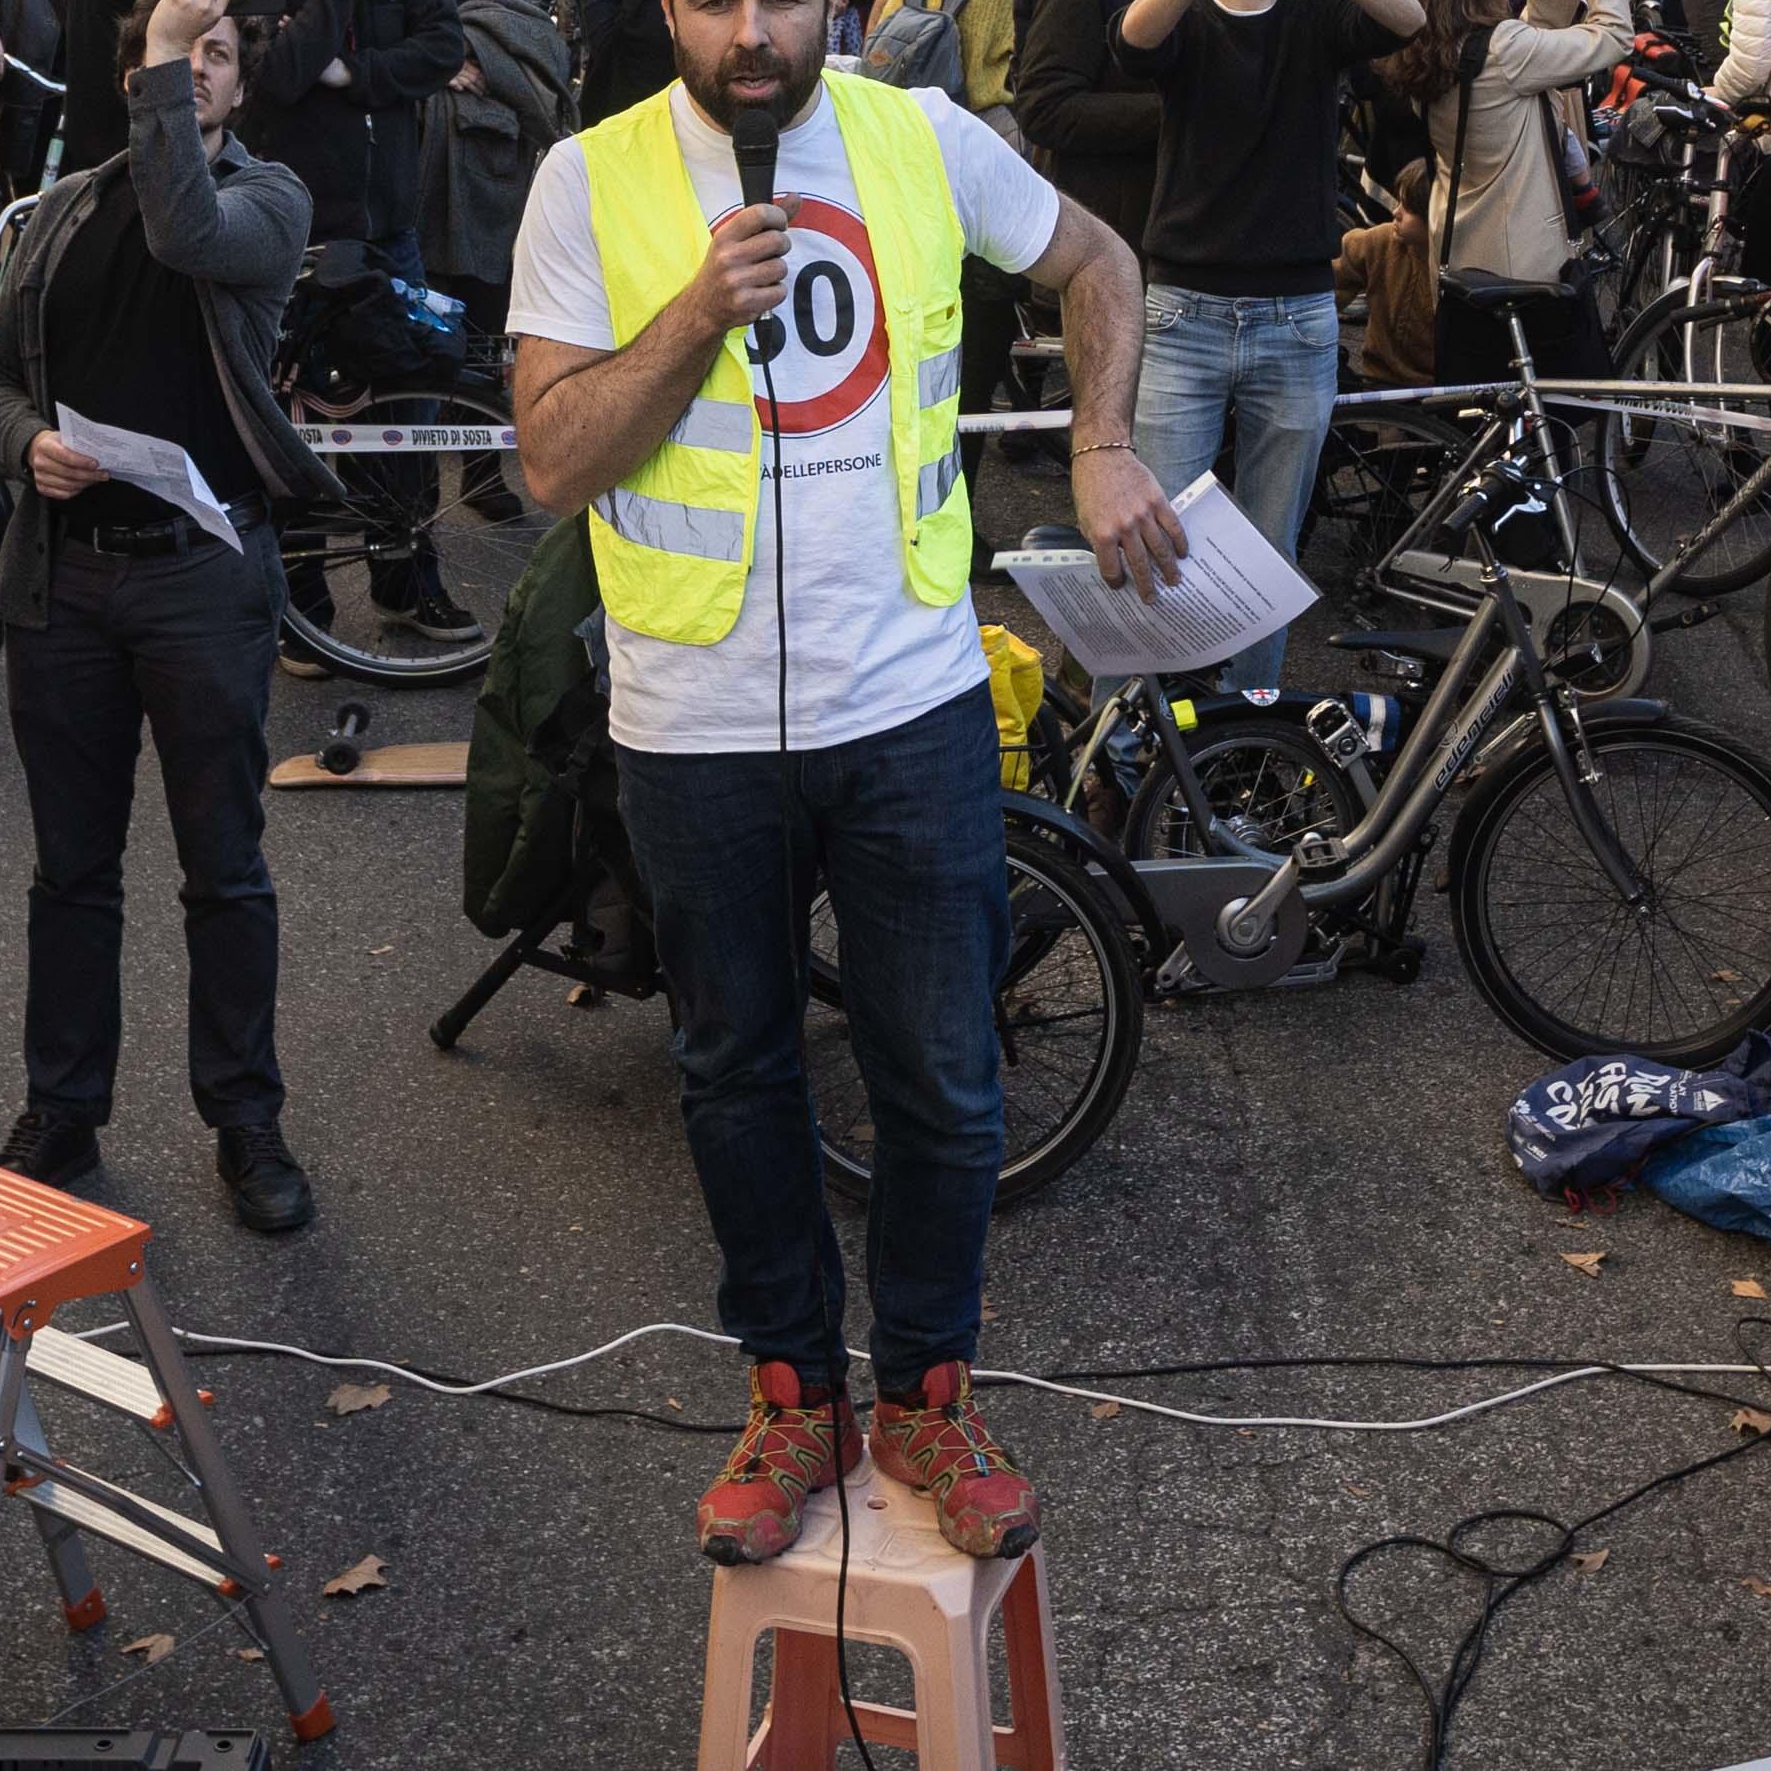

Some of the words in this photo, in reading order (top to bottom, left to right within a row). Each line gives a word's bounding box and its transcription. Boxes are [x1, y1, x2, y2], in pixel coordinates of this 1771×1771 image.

[411, 429, 449, 446] DIVIETO
[451, 429, 460, 446] DI
[462, 429, 493, 446] SOSTA
